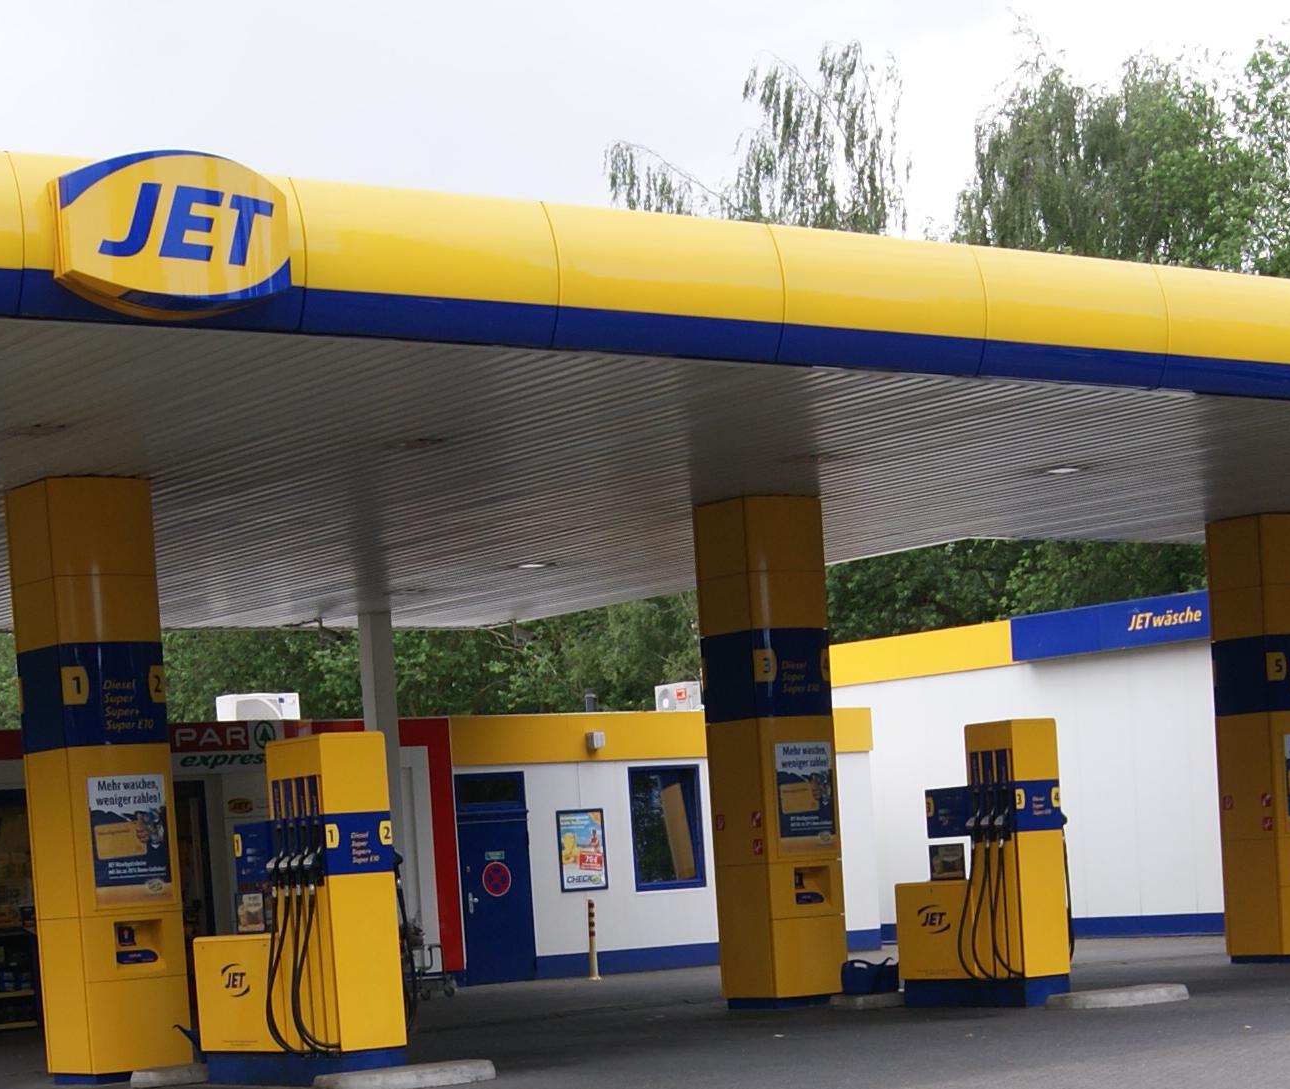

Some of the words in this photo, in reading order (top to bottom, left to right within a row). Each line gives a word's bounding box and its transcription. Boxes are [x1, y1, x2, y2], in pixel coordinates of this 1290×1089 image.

[98, 182, 274, 267] JET
[1275, 658, 1283, 673] 5
[73, 676, 81, 695] 1
[102, 679, 136, 689] Diesel
[153, 675, 162, 693] 2
[103, 693, 134, 704] Super
[105, 706, 140, 718] Super+
[106, 719, 138, 731] Super
[138, 719, 154, 729] E10
[174, 726, 247, 748] PAR
[180, 753, 265, 769] expres
[97, 780, 121, 791] Mehr
[122, 777, 158, 791] waschen,
[96, 795, 131, 808] weniger
[132, 792, 161, 804] zahlen!
[383, 826, 391, 839] 2
[921, 912, 947, 927] JET
[225, 972, 246, 988] JET
